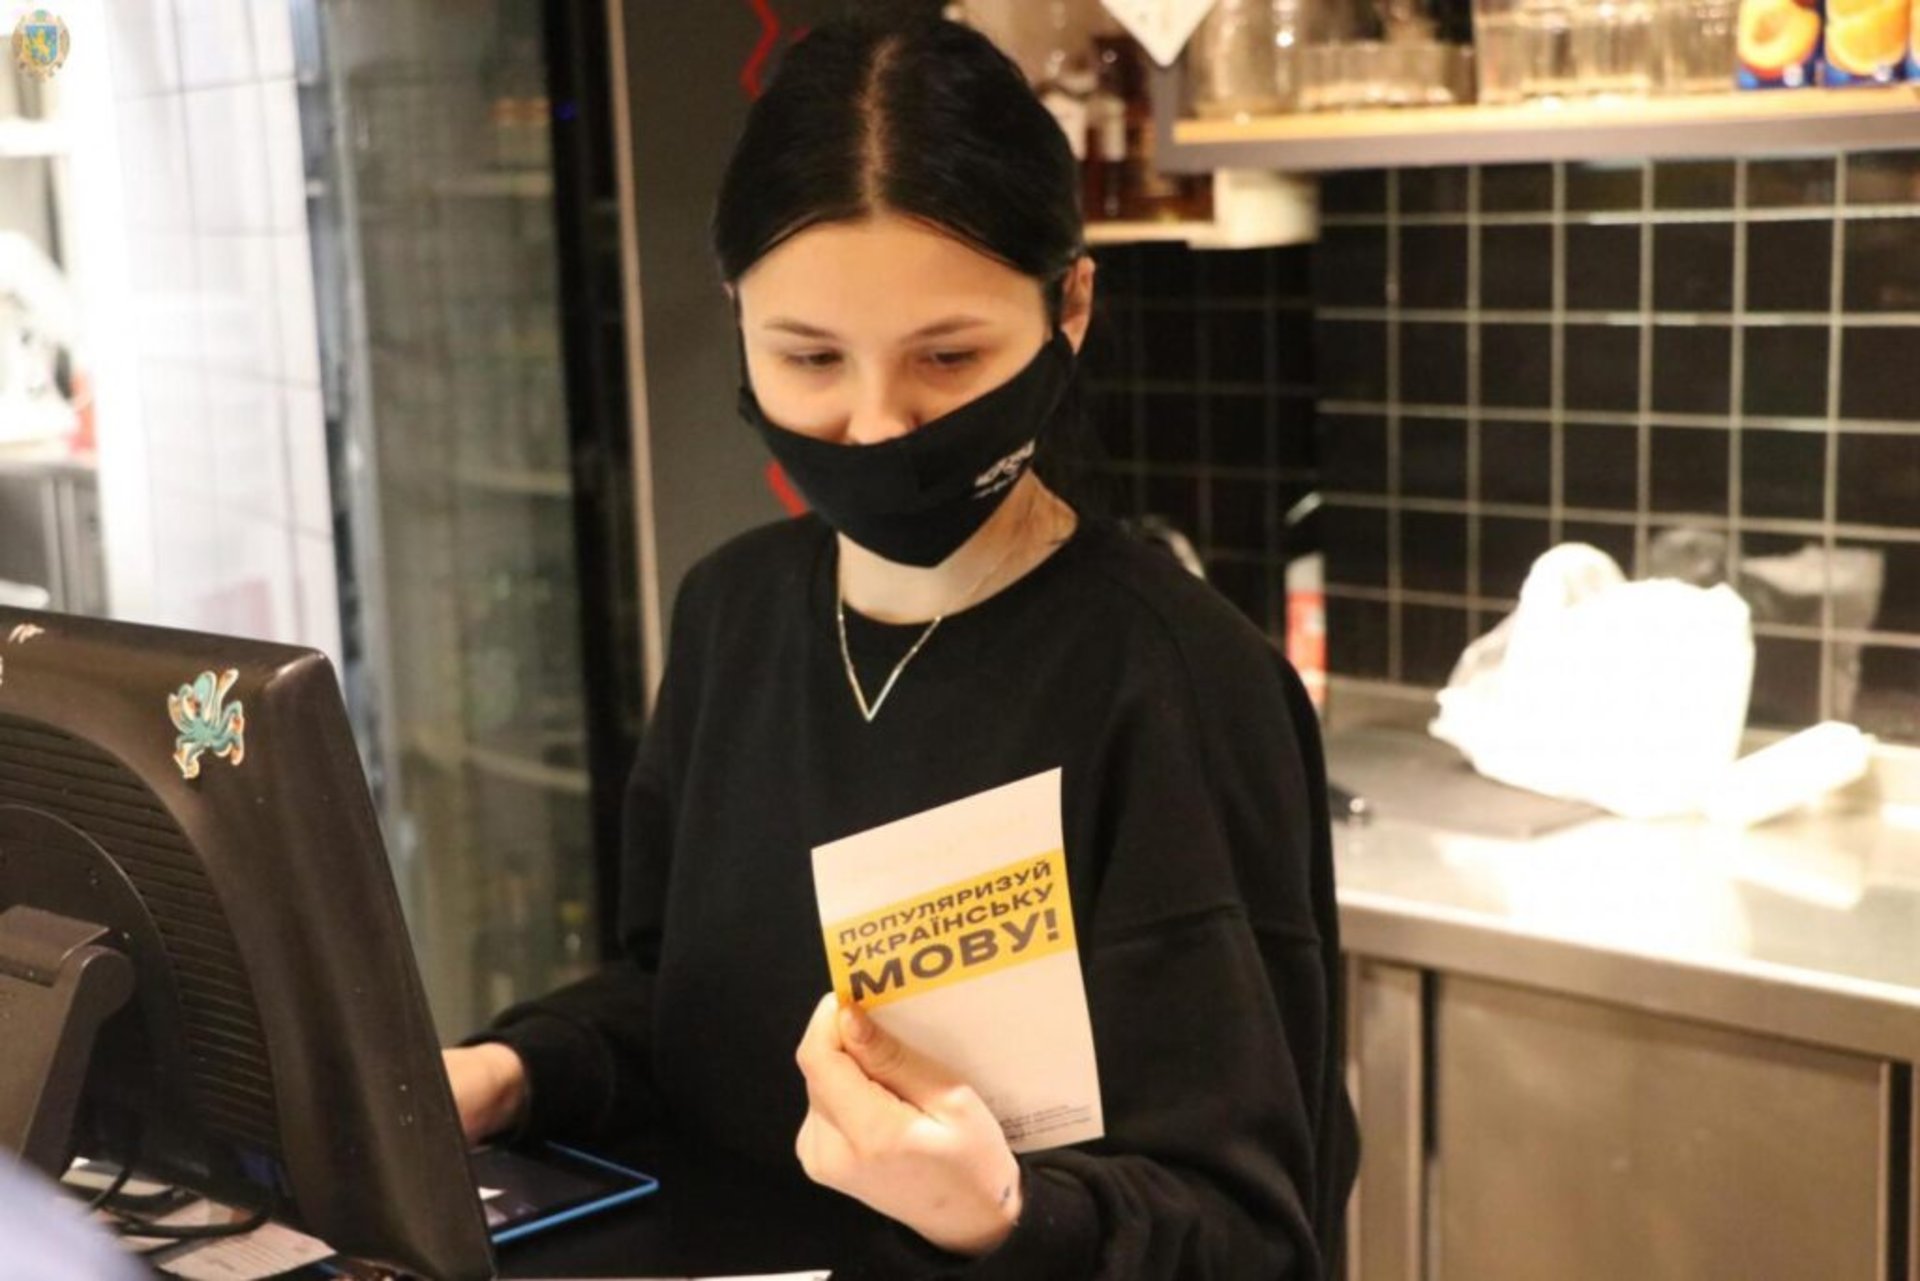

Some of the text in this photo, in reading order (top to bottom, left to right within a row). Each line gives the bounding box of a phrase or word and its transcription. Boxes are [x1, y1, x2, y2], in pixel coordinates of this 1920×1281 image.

[839, 860, 1051, 945] ПОПУЛЯРИЗУЙ
[842, 882, 1054, 967] УКРАЇНСЬКУ
[849, 907, 1060, 1002] МОВУ!
